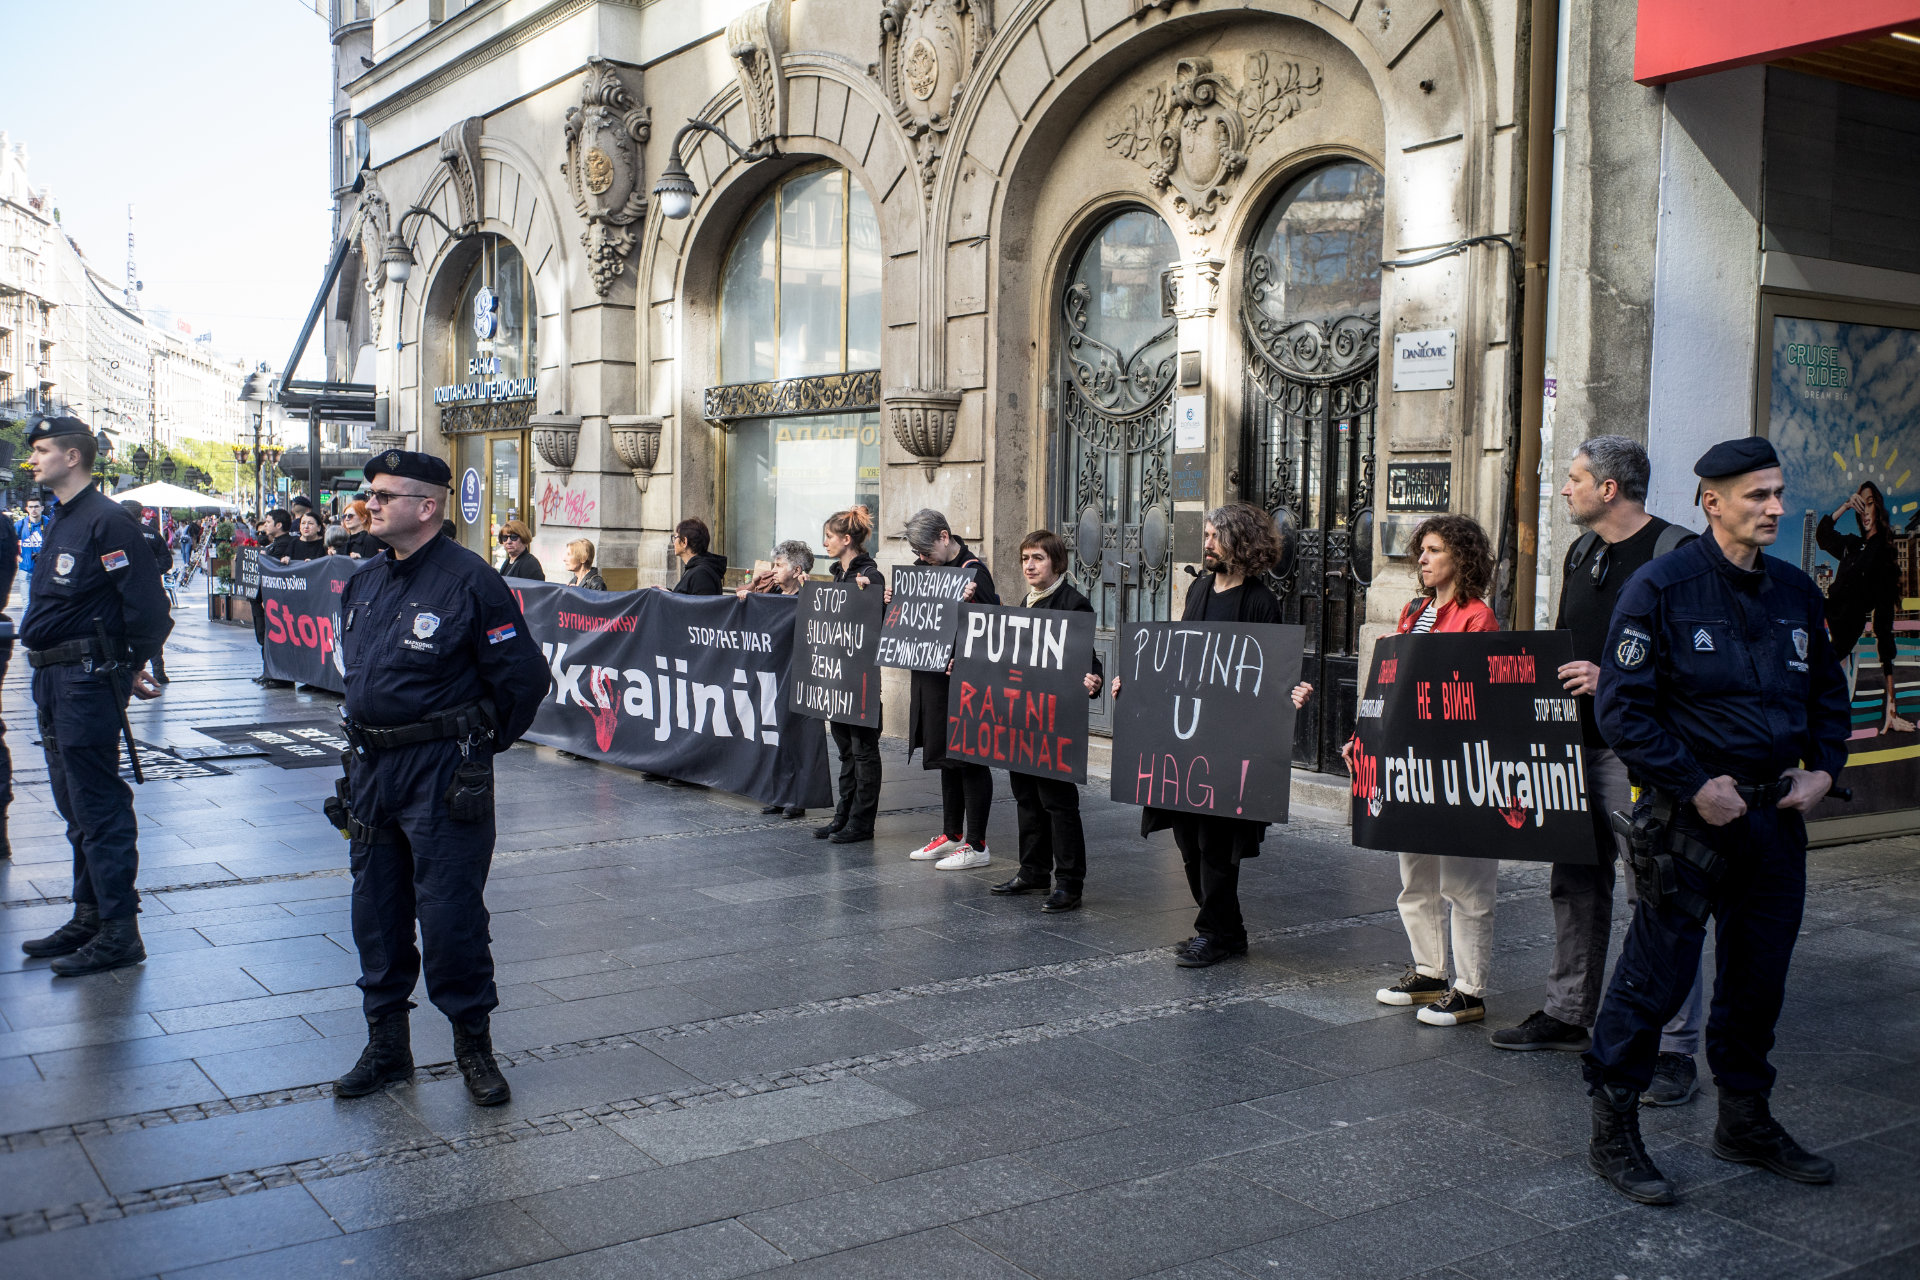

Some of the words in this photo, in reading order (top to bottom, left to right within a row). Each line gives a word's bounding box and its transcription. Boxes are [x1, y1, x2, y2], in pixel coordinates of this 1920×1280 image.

[468, 357, 495, 375] БАНКА
[1787, 343, 1839, 368] CRUISE
[434, 383, 477, 403] ПОШТАНСКА
[1806, 366, 1848, 388] RIDER
[1804, 391, 1832, 400] DREAM
[814, 587, 848, 613] STOP
[885, 601, 944, 631] #RUSKE
[265, 598, 334, 665] Stop
[687, 625, 715, 647] STOP
[714, 629, 740, 650] THE
[740, 631, 772, 653] WAR
[963, 611, 1068, 670] PUTIN
[811, 647, 842, 680] ŽENA
[1133, 628, 1264, 697] PUTINA
[796, 681, 804, 706] U
[806, 686, 853, 719] UKRAJINI
[959, 681, 1057, 733] RATNI
[1416, 681, 1432, 720] НЕ
[1441, 670, 1477, 721] ВІЙНІ
[1534, 698, 1549, 722] STOP
[1549, 698, 1562, 722] THE
[1561, 698, 1578, 722] WAR
[1173, 695, 1202, 740] U
[948, 714, 1073, 774] ZLOČINAC
[1135, 752, 1215, 810] HAG
[1352, 737, 1377, 817] Stop
[1385, 746, 1435, 804] ratu
[1441, 759, 1461, 806] u
[1463, 740, 1588, 828] Ukrajini!
